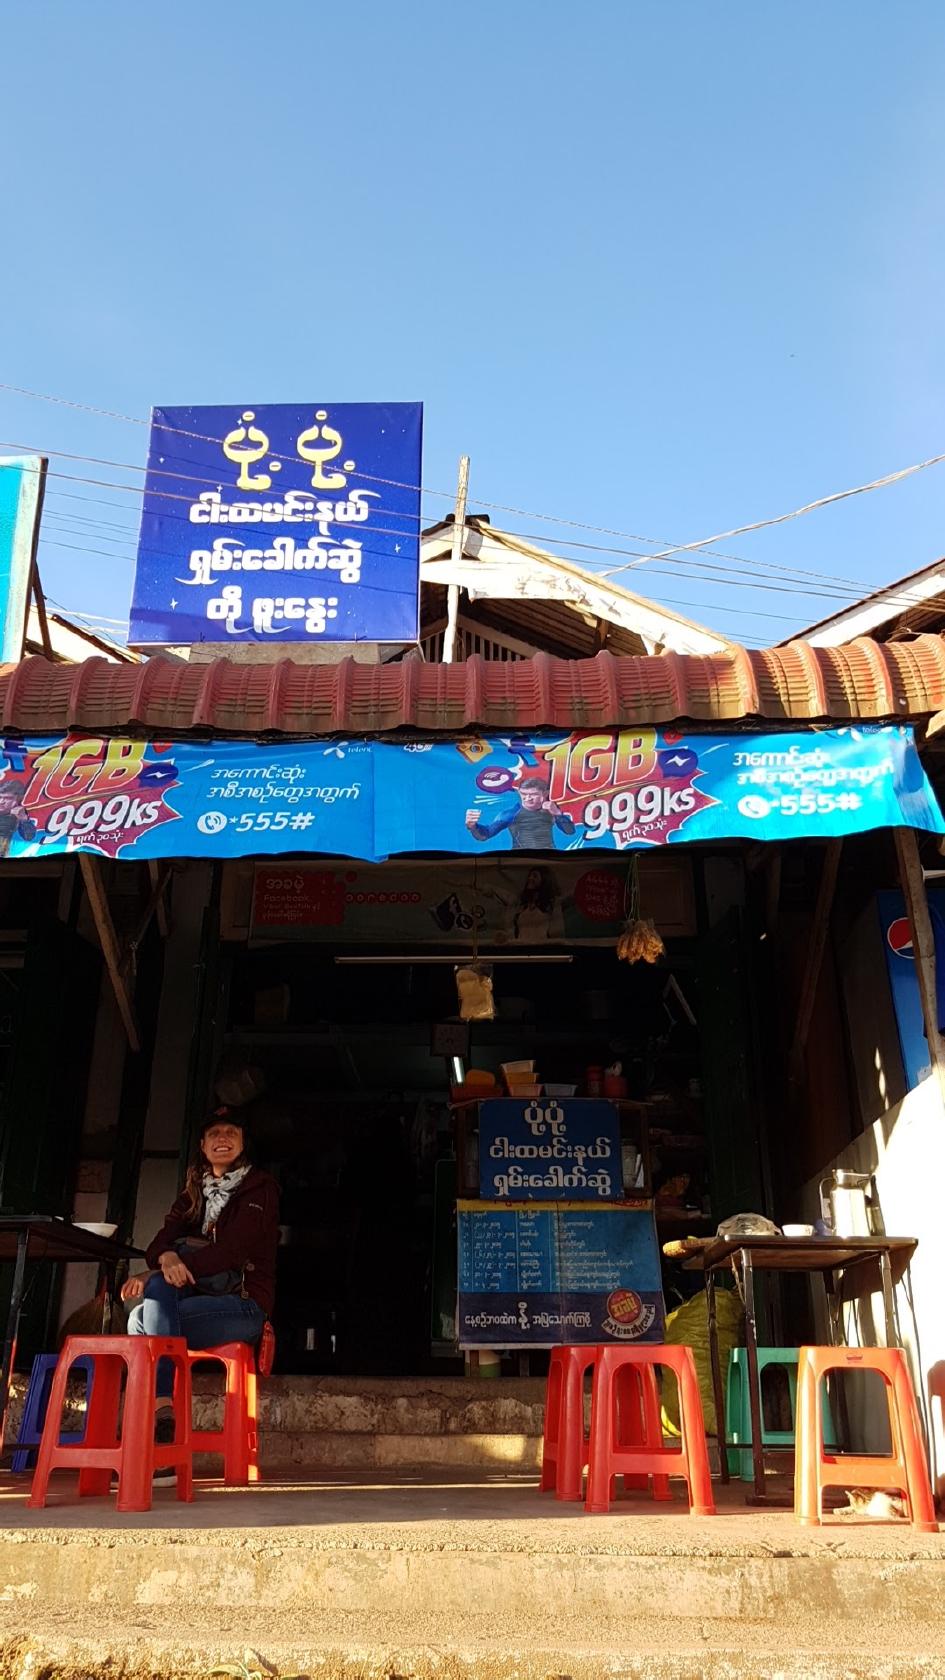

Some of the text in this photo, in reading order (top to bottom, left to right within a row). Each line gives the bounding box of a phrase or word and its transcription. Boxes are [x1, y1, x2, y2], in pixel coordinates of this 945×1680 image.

[175, 537, 363, 584] ရှမ်းခေါက်ဆွဲ
[21, 738, 147, 806] 1GB
[211, 764, 306, 784] အကောင်းဆုံး
[545, 727, 658, 801] 1GB
[345, 893, 419, 902] ooredoo
[489, 1136, 612, 1166] ငါးထမင်းနယ်
[493, 1165, 612, 1196] ရှမ်းခေါက်ဆွဲ
